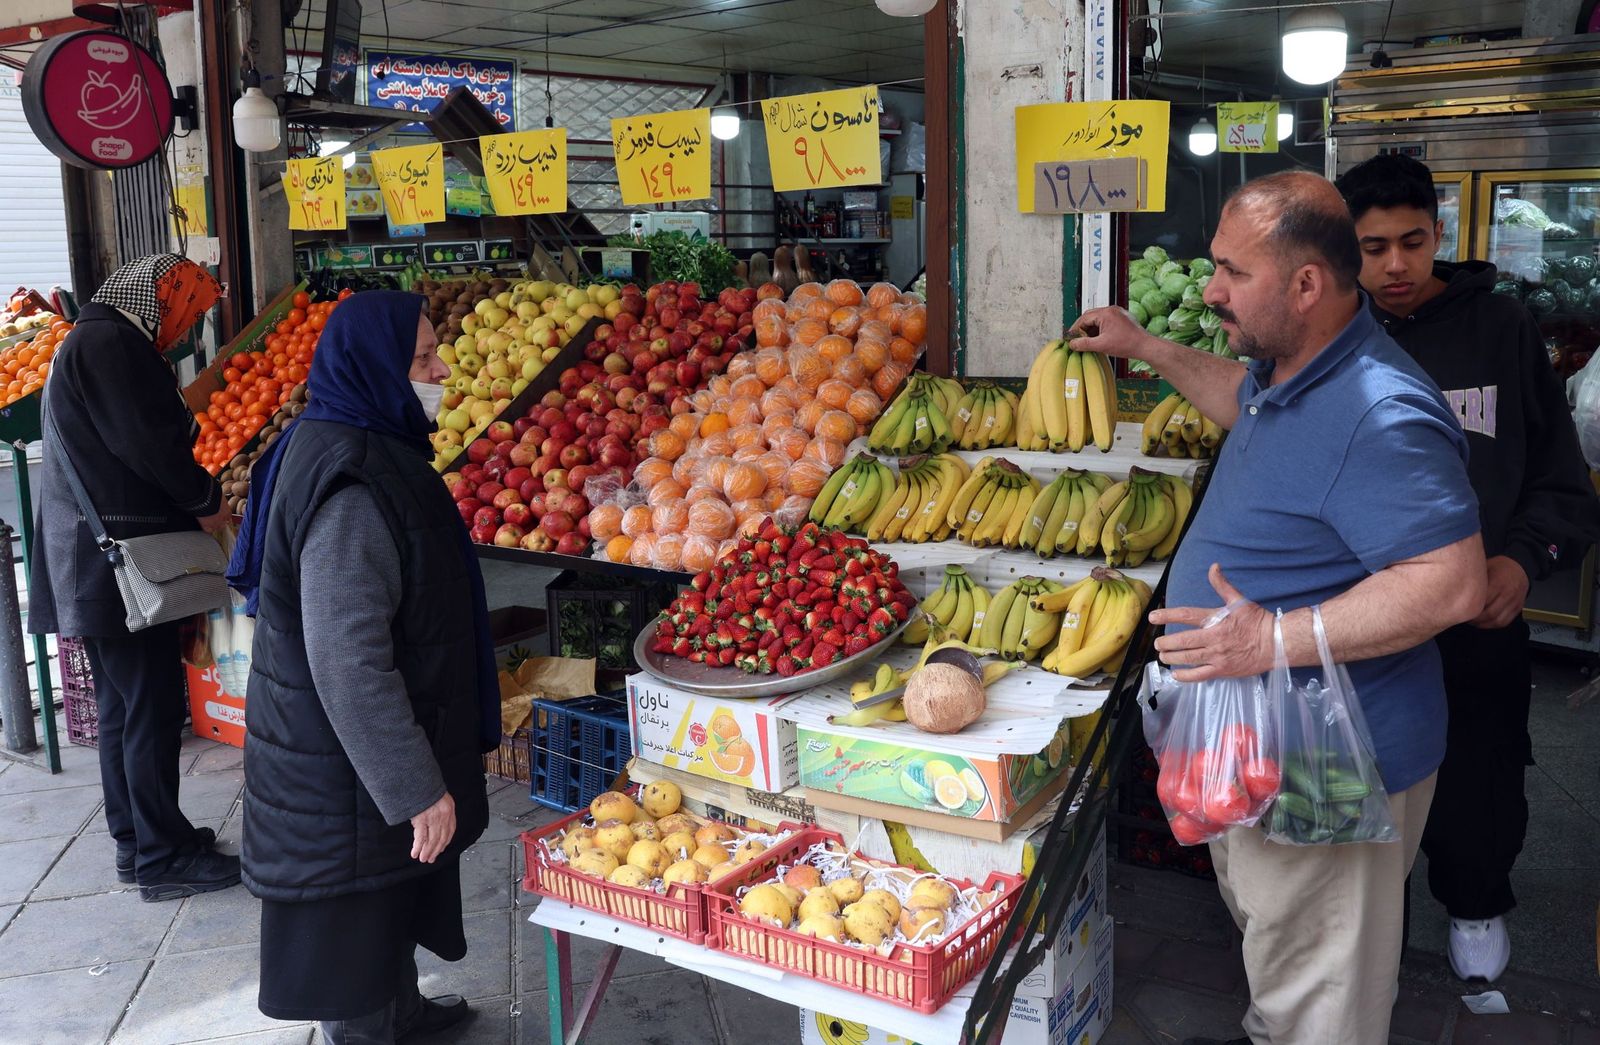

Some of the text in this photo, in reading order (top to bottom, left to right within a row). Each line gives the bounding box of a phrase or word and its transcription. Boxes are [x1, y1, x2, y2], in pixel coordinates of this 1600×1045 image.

[392, 60, 423, 77] دسته
[424, 61, 450, 78] شده
[452, 62, 476, 85] پاک
[477, 67, 510, 85] سبزی
[377, 81, 423, 100] بهداشتی
[810, 92, 877, 134] تامسون
[624, 121, 655, 161] قرمز
[1095, 110, 1143, 151] موز
[98, 140, 125, 150] Snapp!
[98, 148, 118, 157] Food
[657, 126, 702, 159] سیب
[399, 145, 440, 187] کیوی
[493, 141, 517, 176] زرد
[518, 143, 558, 173] سیب
[639, 689, 669, 711] ناول
[640, 712, 669, 733] پرتقال
[641, 738, 664, 753] جیرفت
[1010, 1011, 1041, 1024] CAVENDISH
[1014, 1004, 1039, 1016] QUALITY
